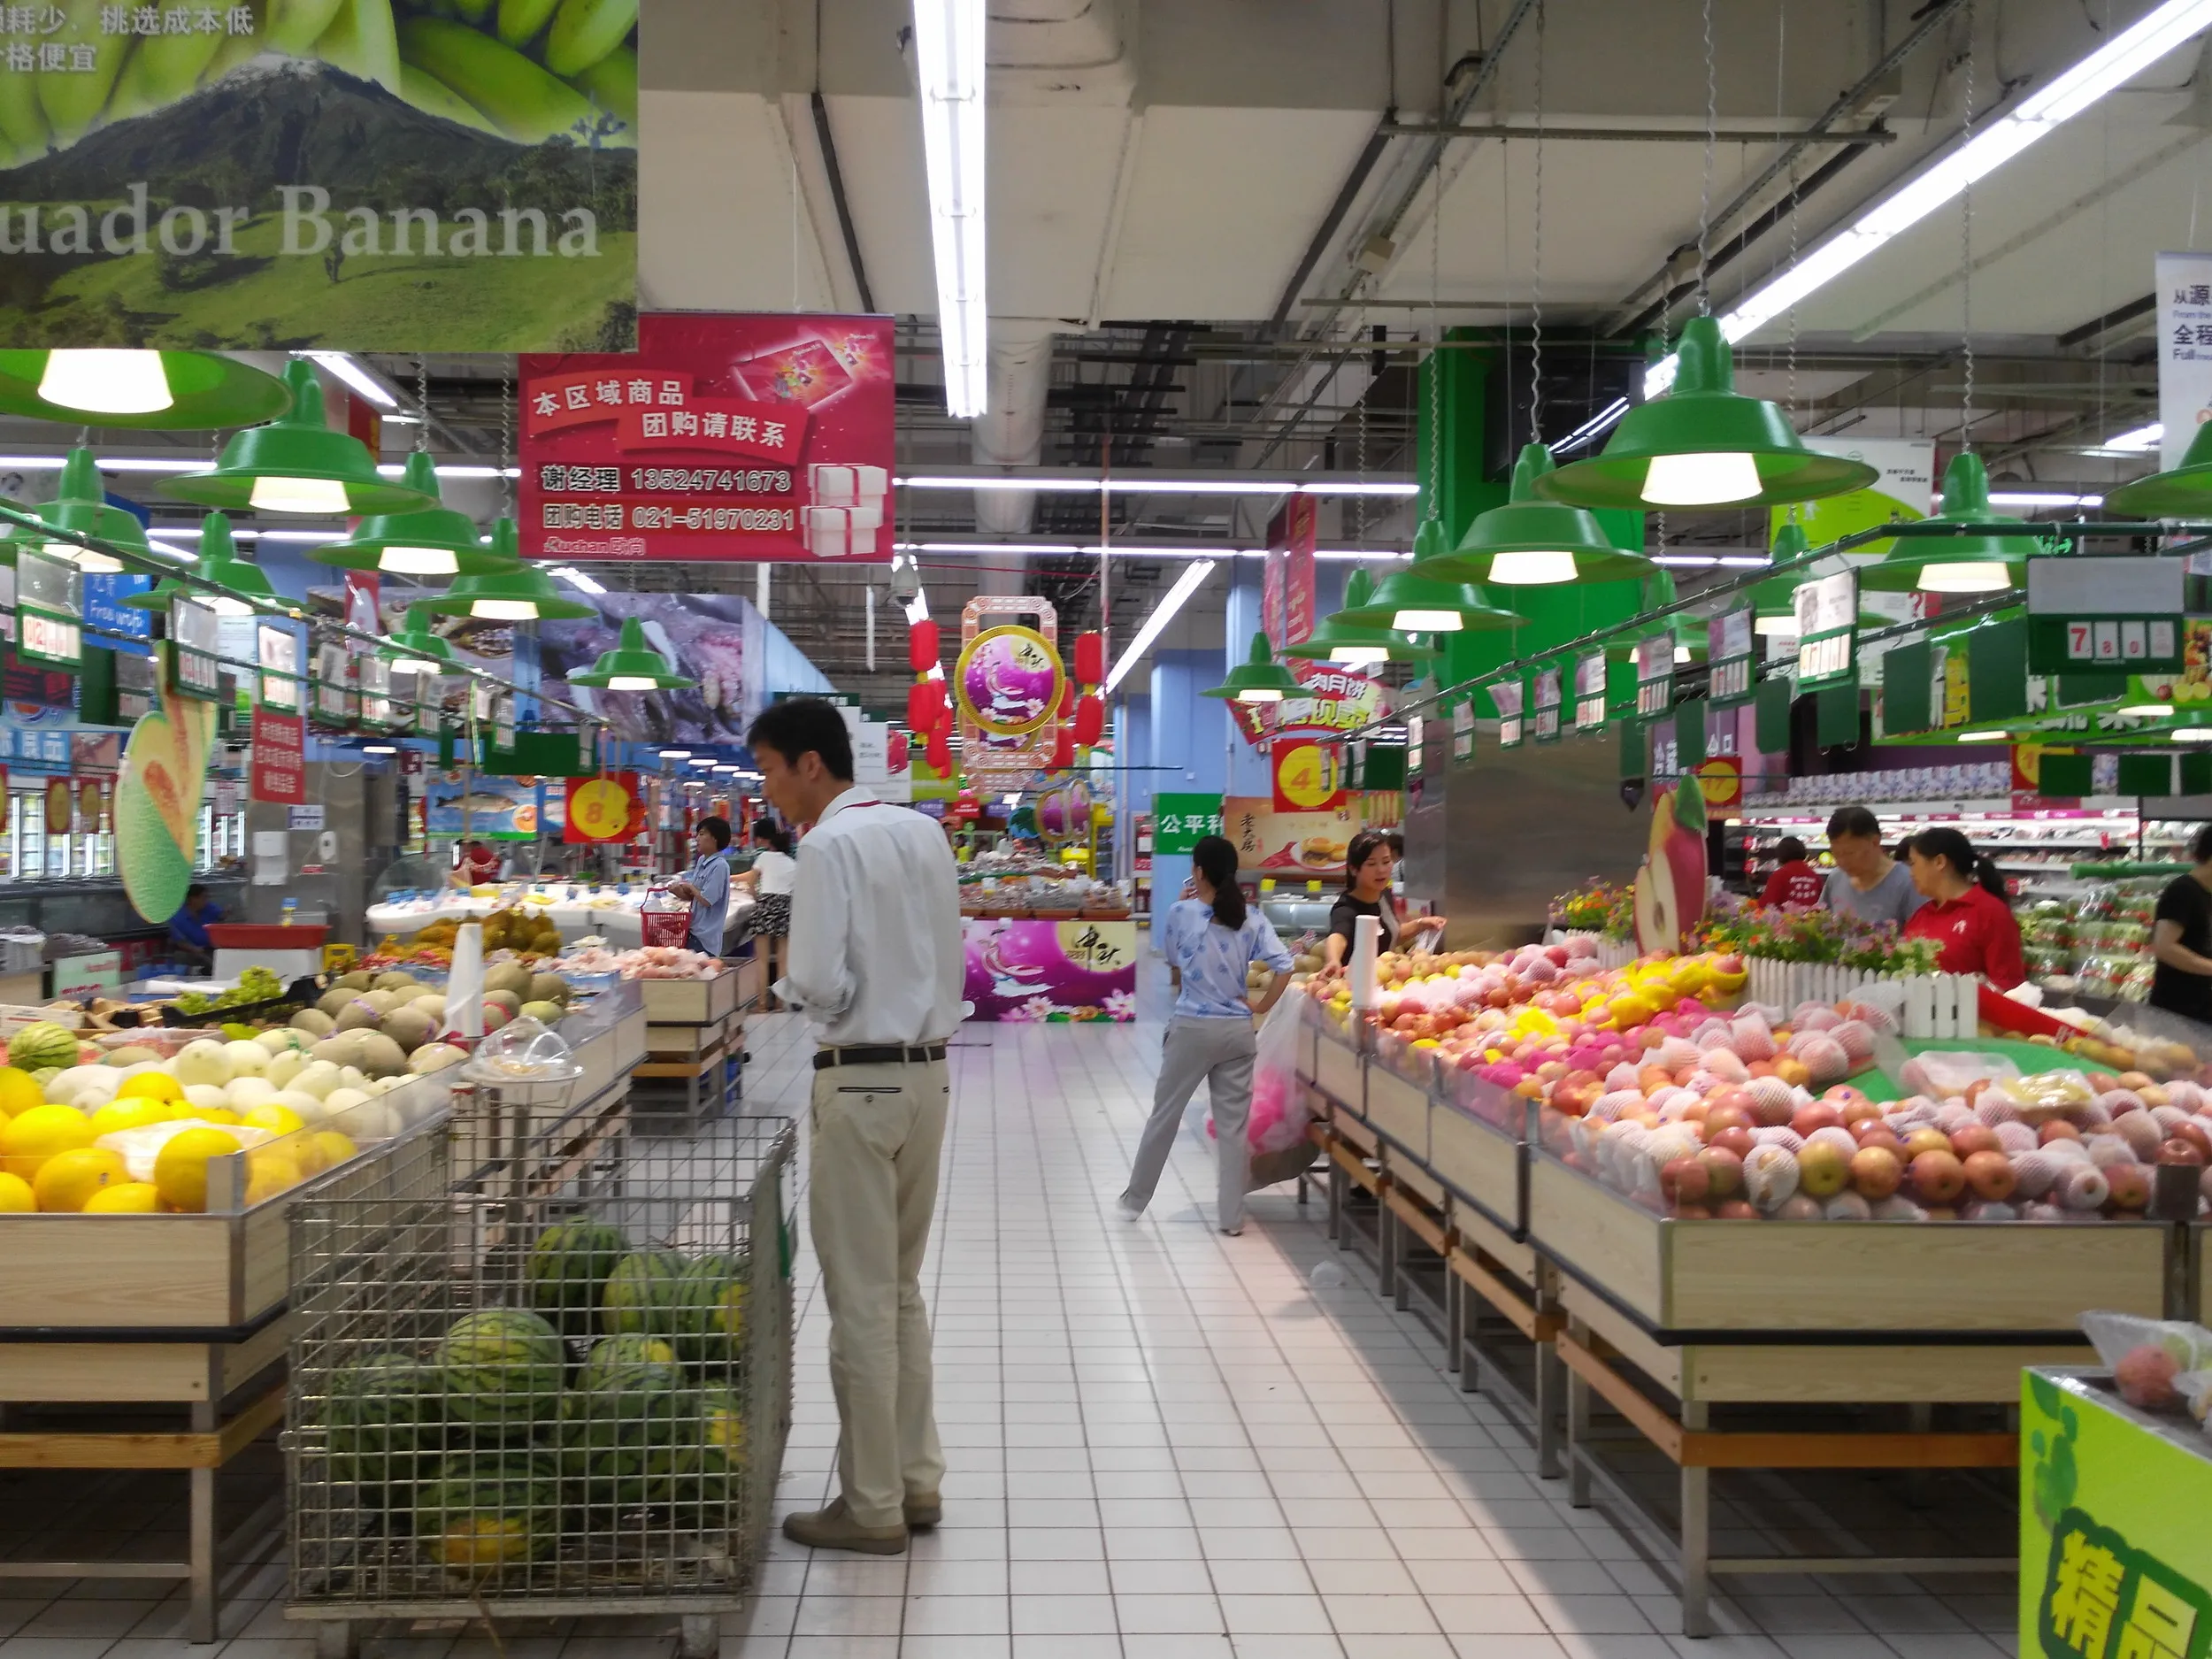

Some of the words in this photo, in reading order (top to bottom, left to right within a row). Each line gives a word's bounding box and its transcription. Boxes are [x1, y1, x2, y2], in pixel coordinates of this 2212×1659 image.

[0, 42, 96, 72] 格便宜
[275, 184, 603, 257] Banana
[533, 379, 684, 417] 本区域商品
[641, 411, 787, 449] 团购请联系
[541, 465, 620, 492] 谢经理
[631, 468, 792, 492] 13524741673
[542, 503, 624, 530] 团购电话
[632, 507, 795, 531] 021-51970231
